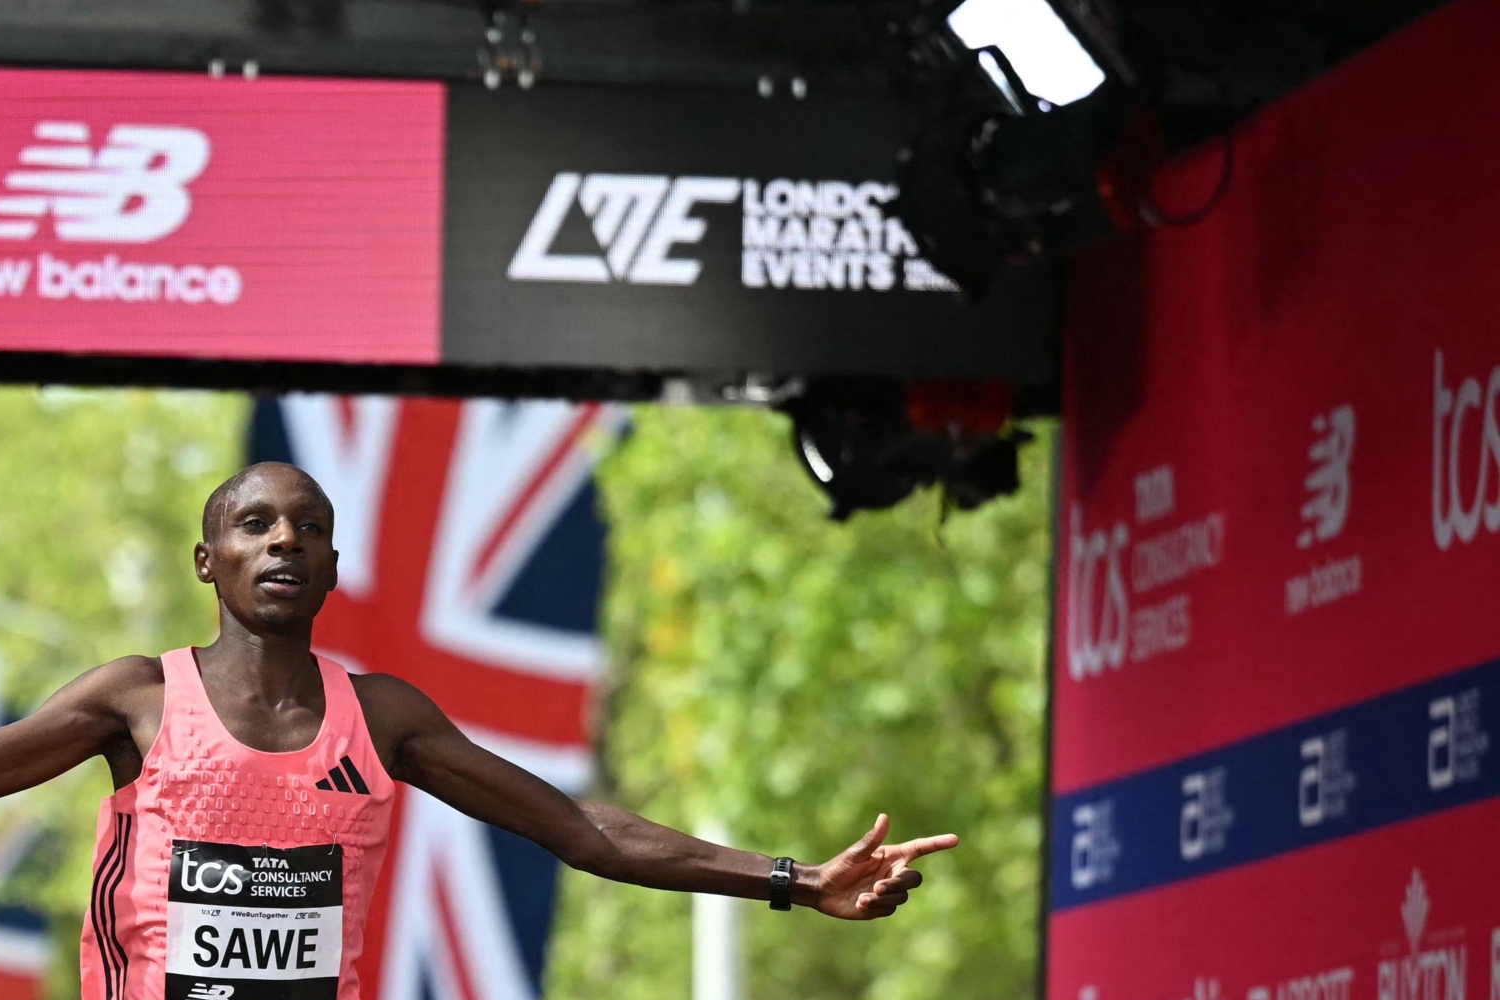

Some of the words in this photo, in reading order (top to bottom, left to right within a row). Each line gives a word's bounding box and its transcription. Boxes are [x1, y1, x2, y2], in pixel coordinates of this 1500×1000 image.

[38, 253, 242, 303] balance
[742, 250, 896, 291] EVENTS
[181, 852, 244, 895] tcs
[251, 870, 333, 883] CONSULTANCY
[252, 858, 289, 869] TATA
[250, 886, 307, 897] SERVICES
[231, 911, 288, 919] #WeRunTogether
[193, 925, 319, 970] SAWE
